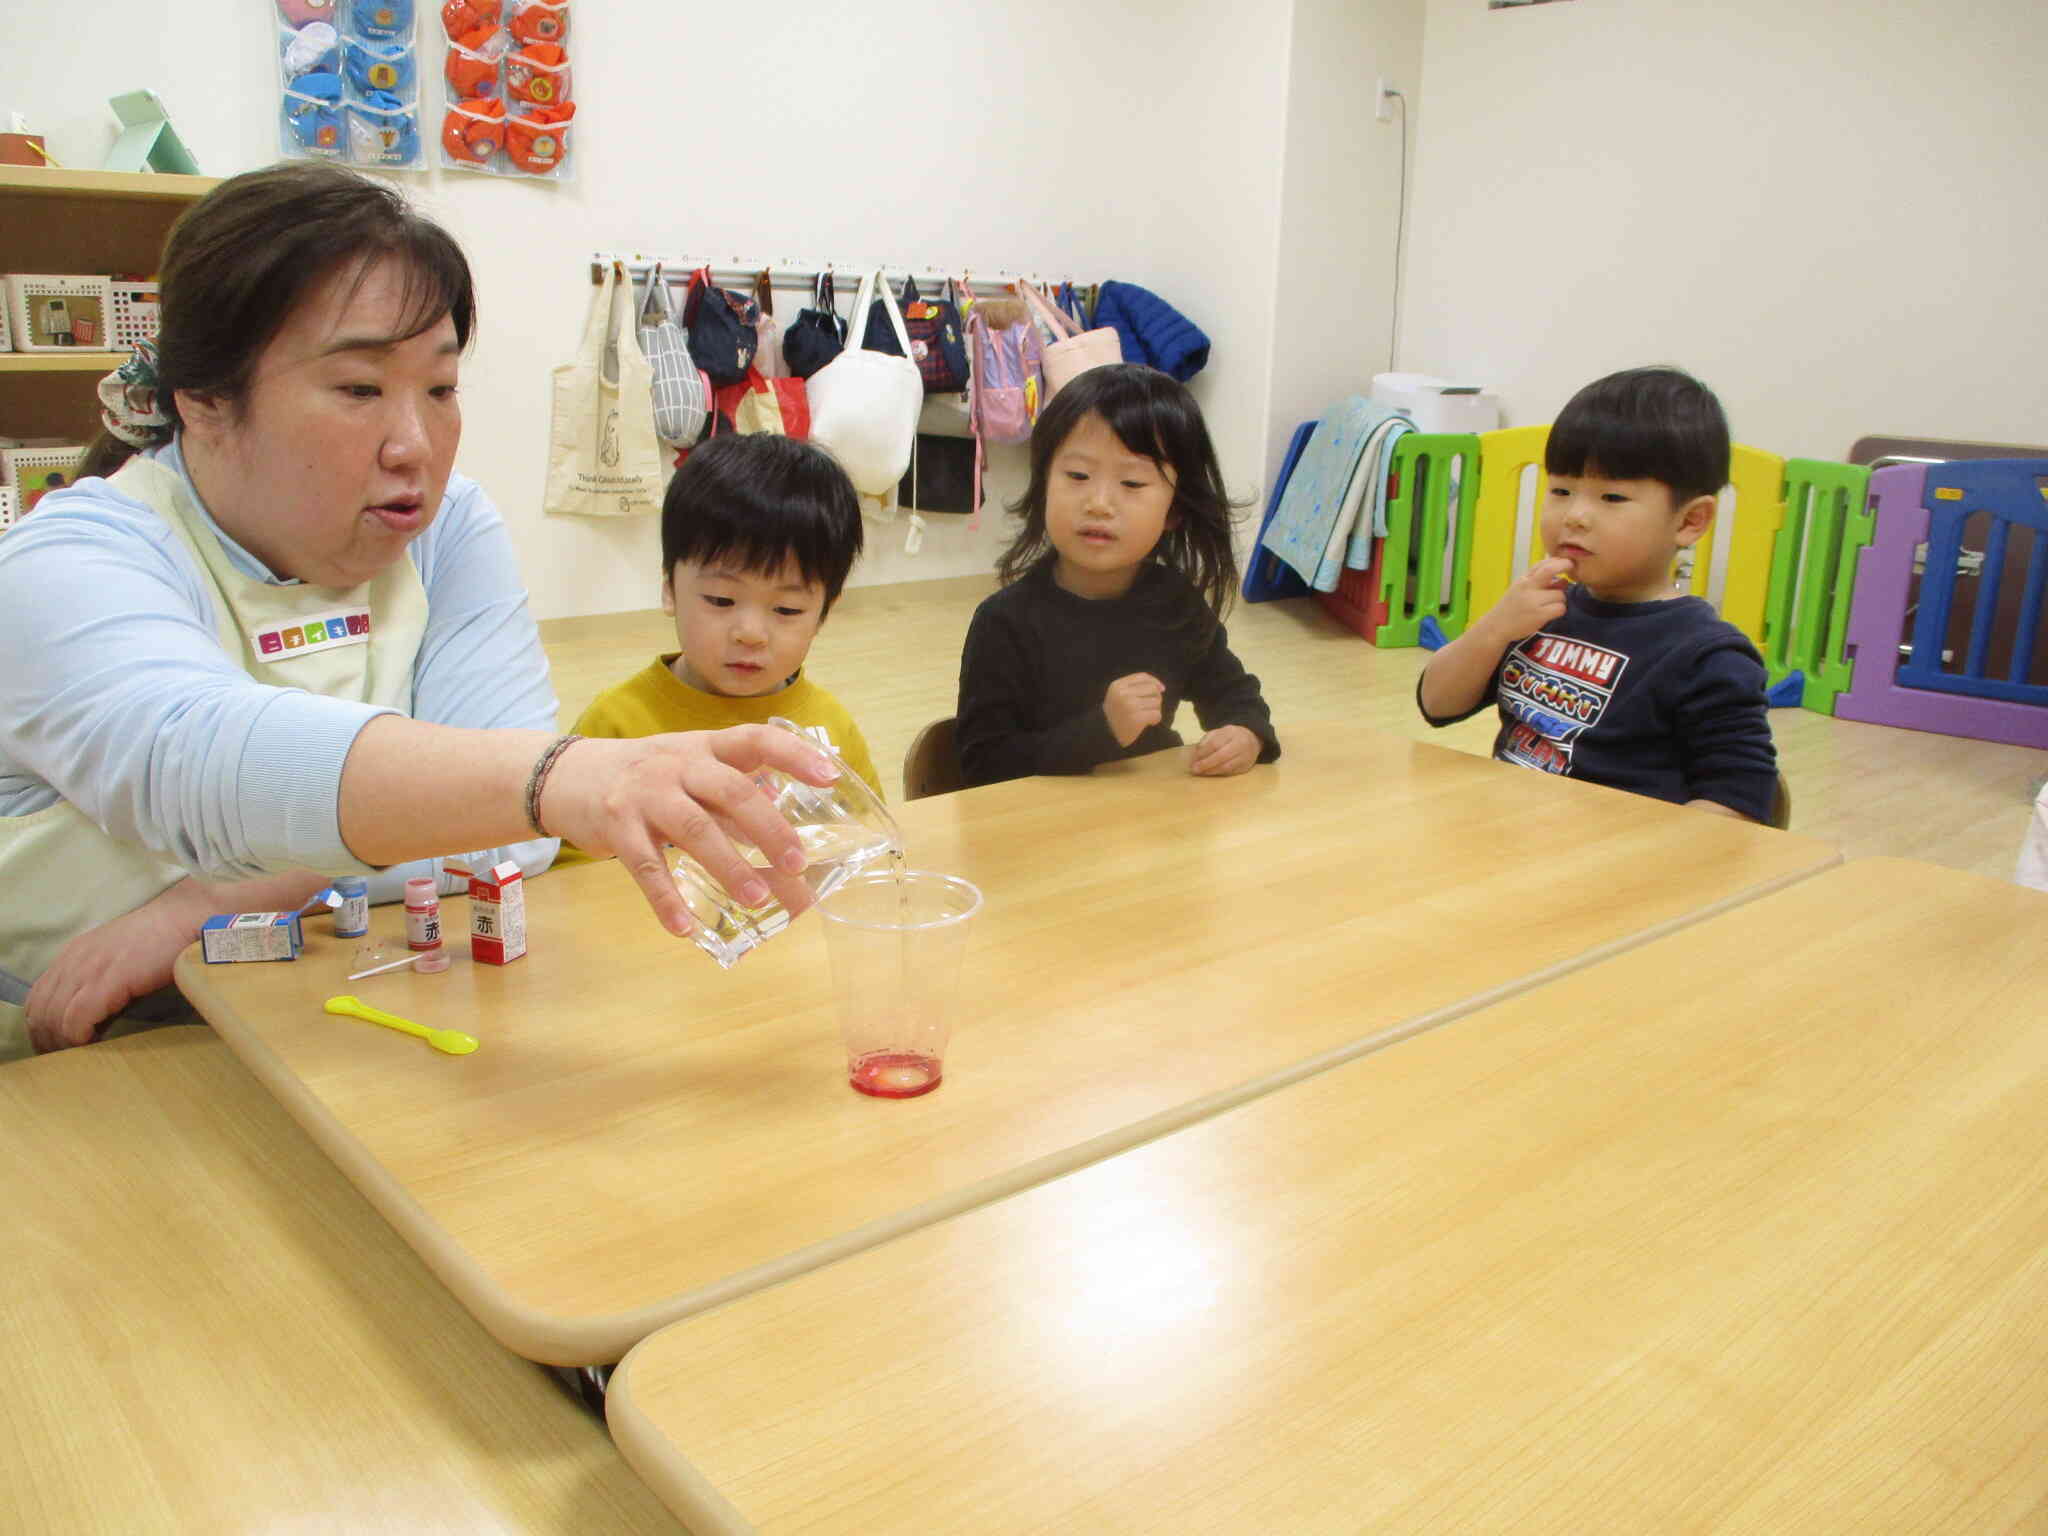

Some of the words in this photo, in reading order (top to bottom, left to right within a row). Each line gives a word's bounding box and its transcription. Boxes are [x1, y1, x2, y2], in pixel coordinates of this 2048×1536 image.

[1535, 638, 1617, 680] TOMMY
[1503, 659, 1601, 721] START
[1512, 722, 1568, 773] PLAY
[425, 921, 440, 941] 赤
[477, 915, 494, 934] 赤
